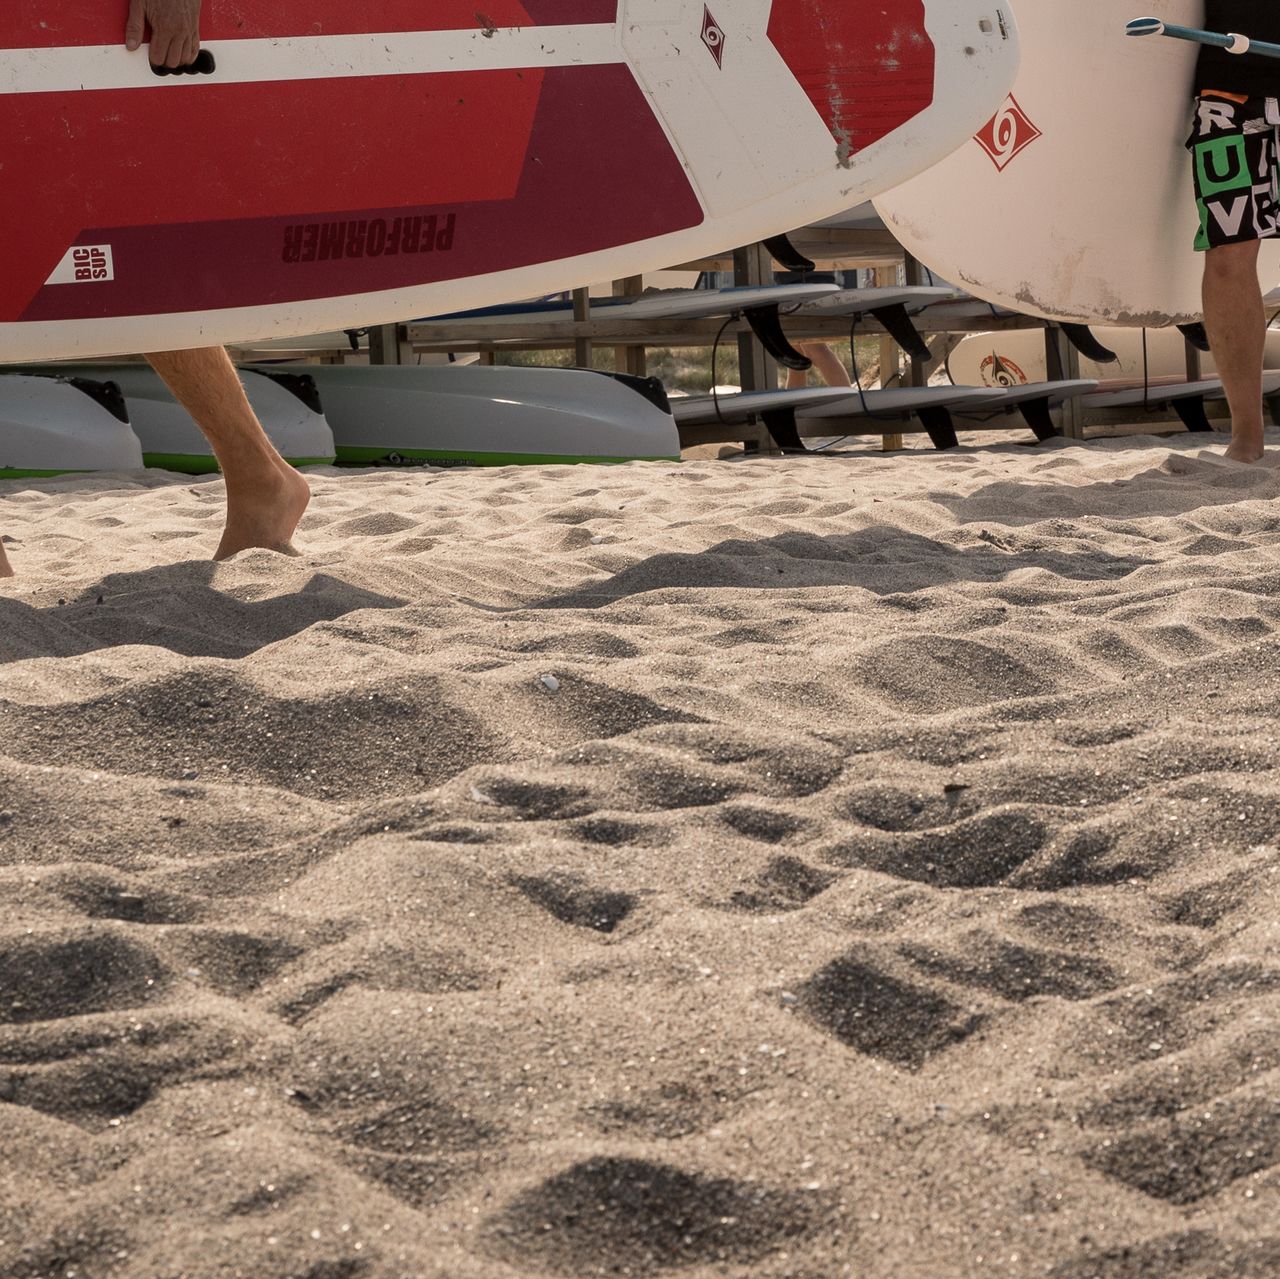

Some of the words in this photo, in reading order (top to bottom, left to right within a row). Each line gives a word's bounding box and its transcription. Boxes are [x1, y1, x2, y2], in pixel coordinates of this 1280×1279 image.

[282, 213, 456, 264] PERFORMER
[73, 248, 92, 280] BIC
[90, 247, 107, 279] SUP
